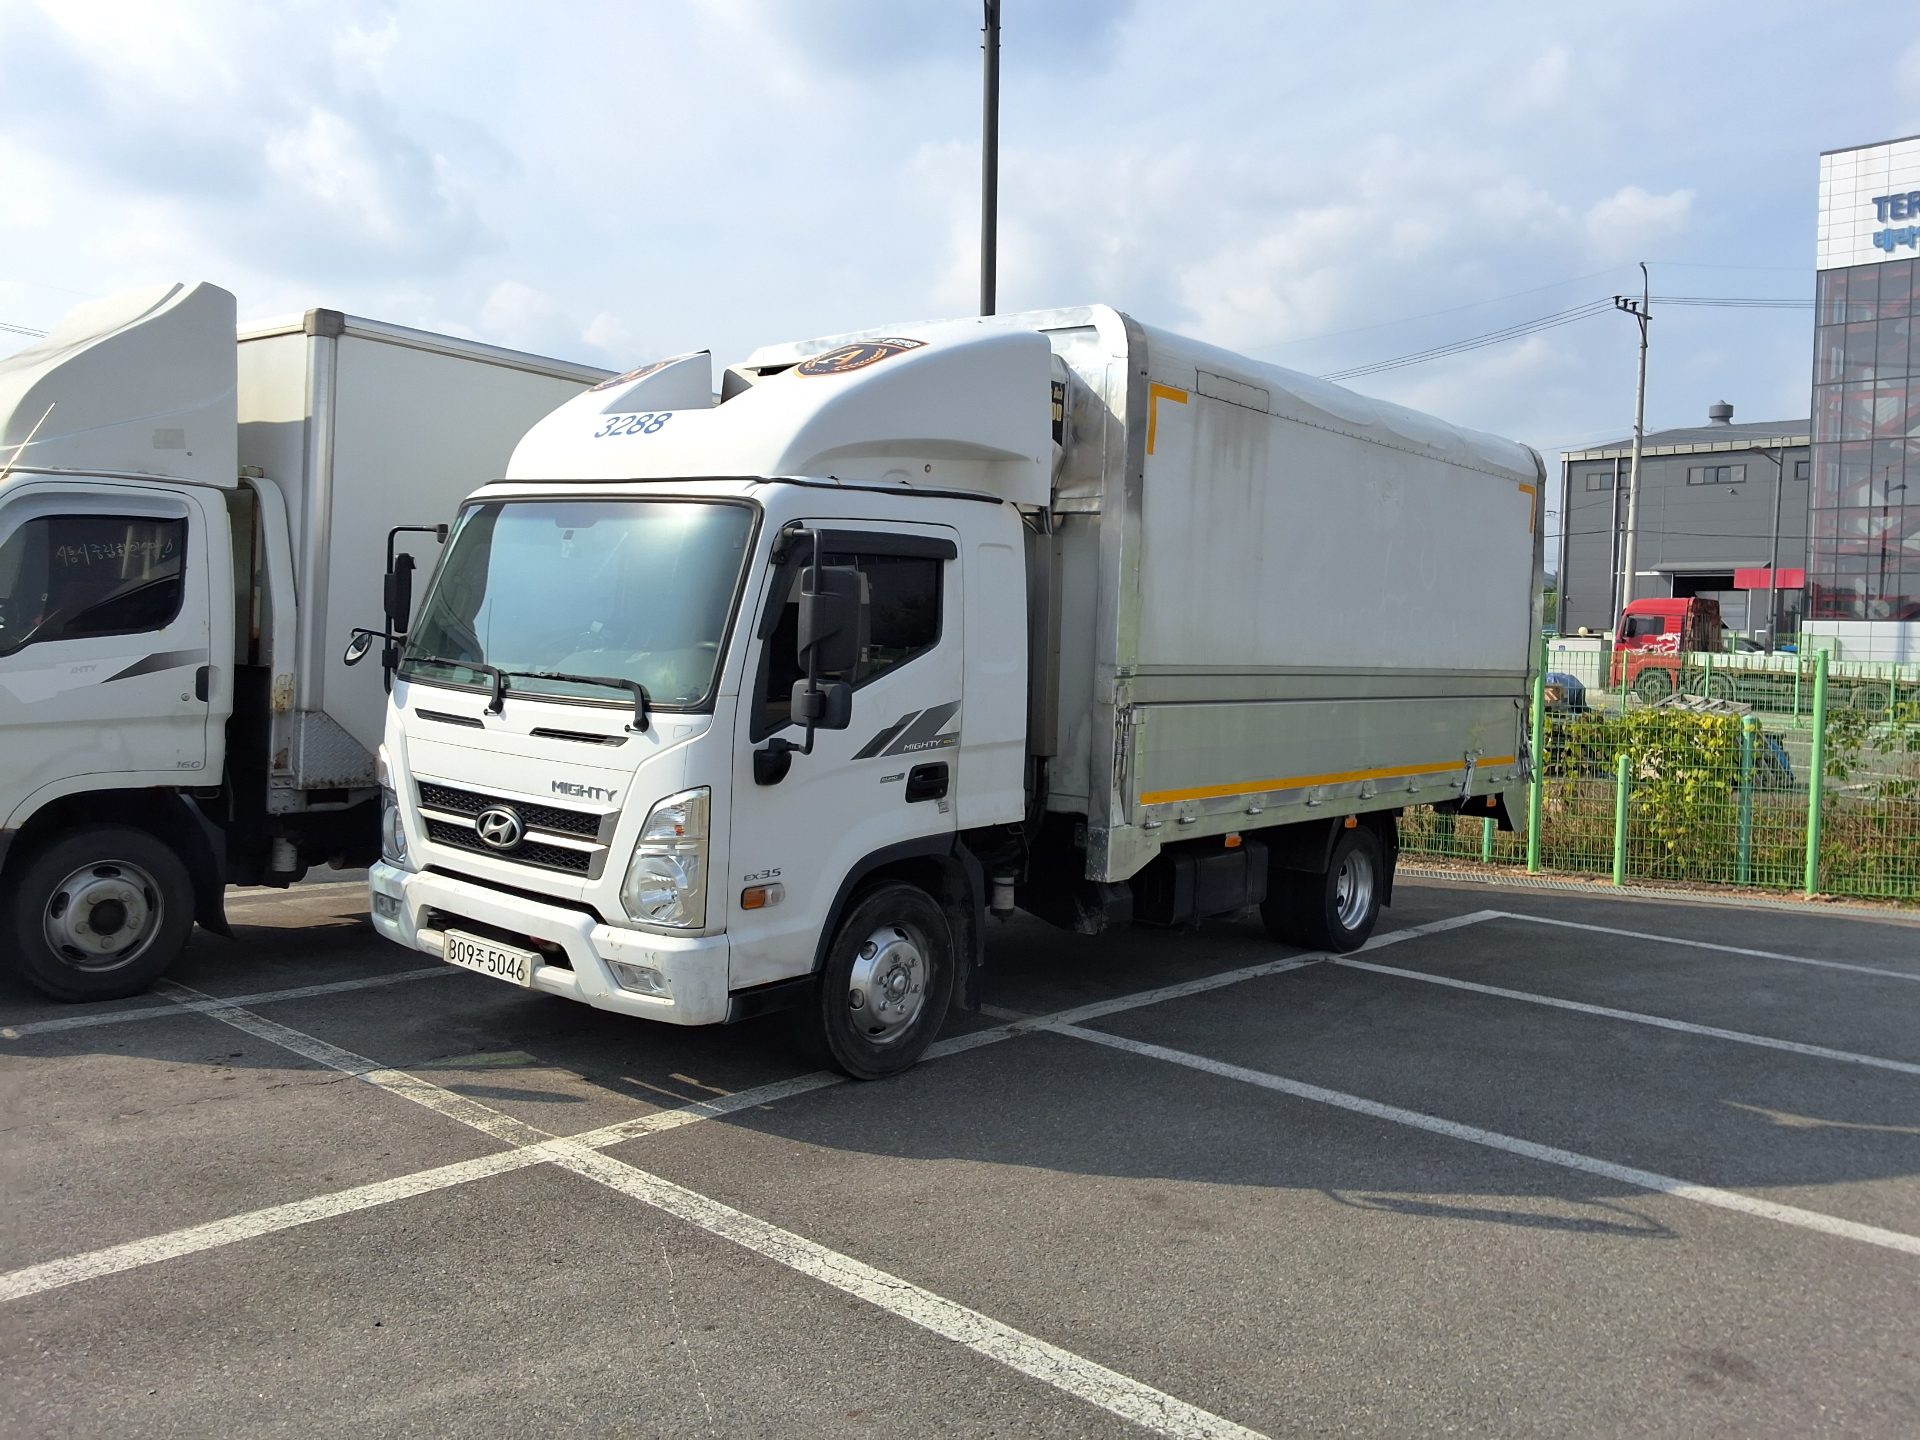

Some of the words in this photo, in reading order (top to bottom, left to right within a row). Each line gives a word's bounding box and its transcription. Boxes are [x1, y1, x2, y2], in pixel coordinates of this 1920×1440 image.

[594, 411, 672, 438] 3288
[903, 739, 942, 751] MIGHTY
[551, 780, 618, 802] MIGHTY
[448, 938, 486, 968] 809주
[487, 950, 526, 982] 5046
